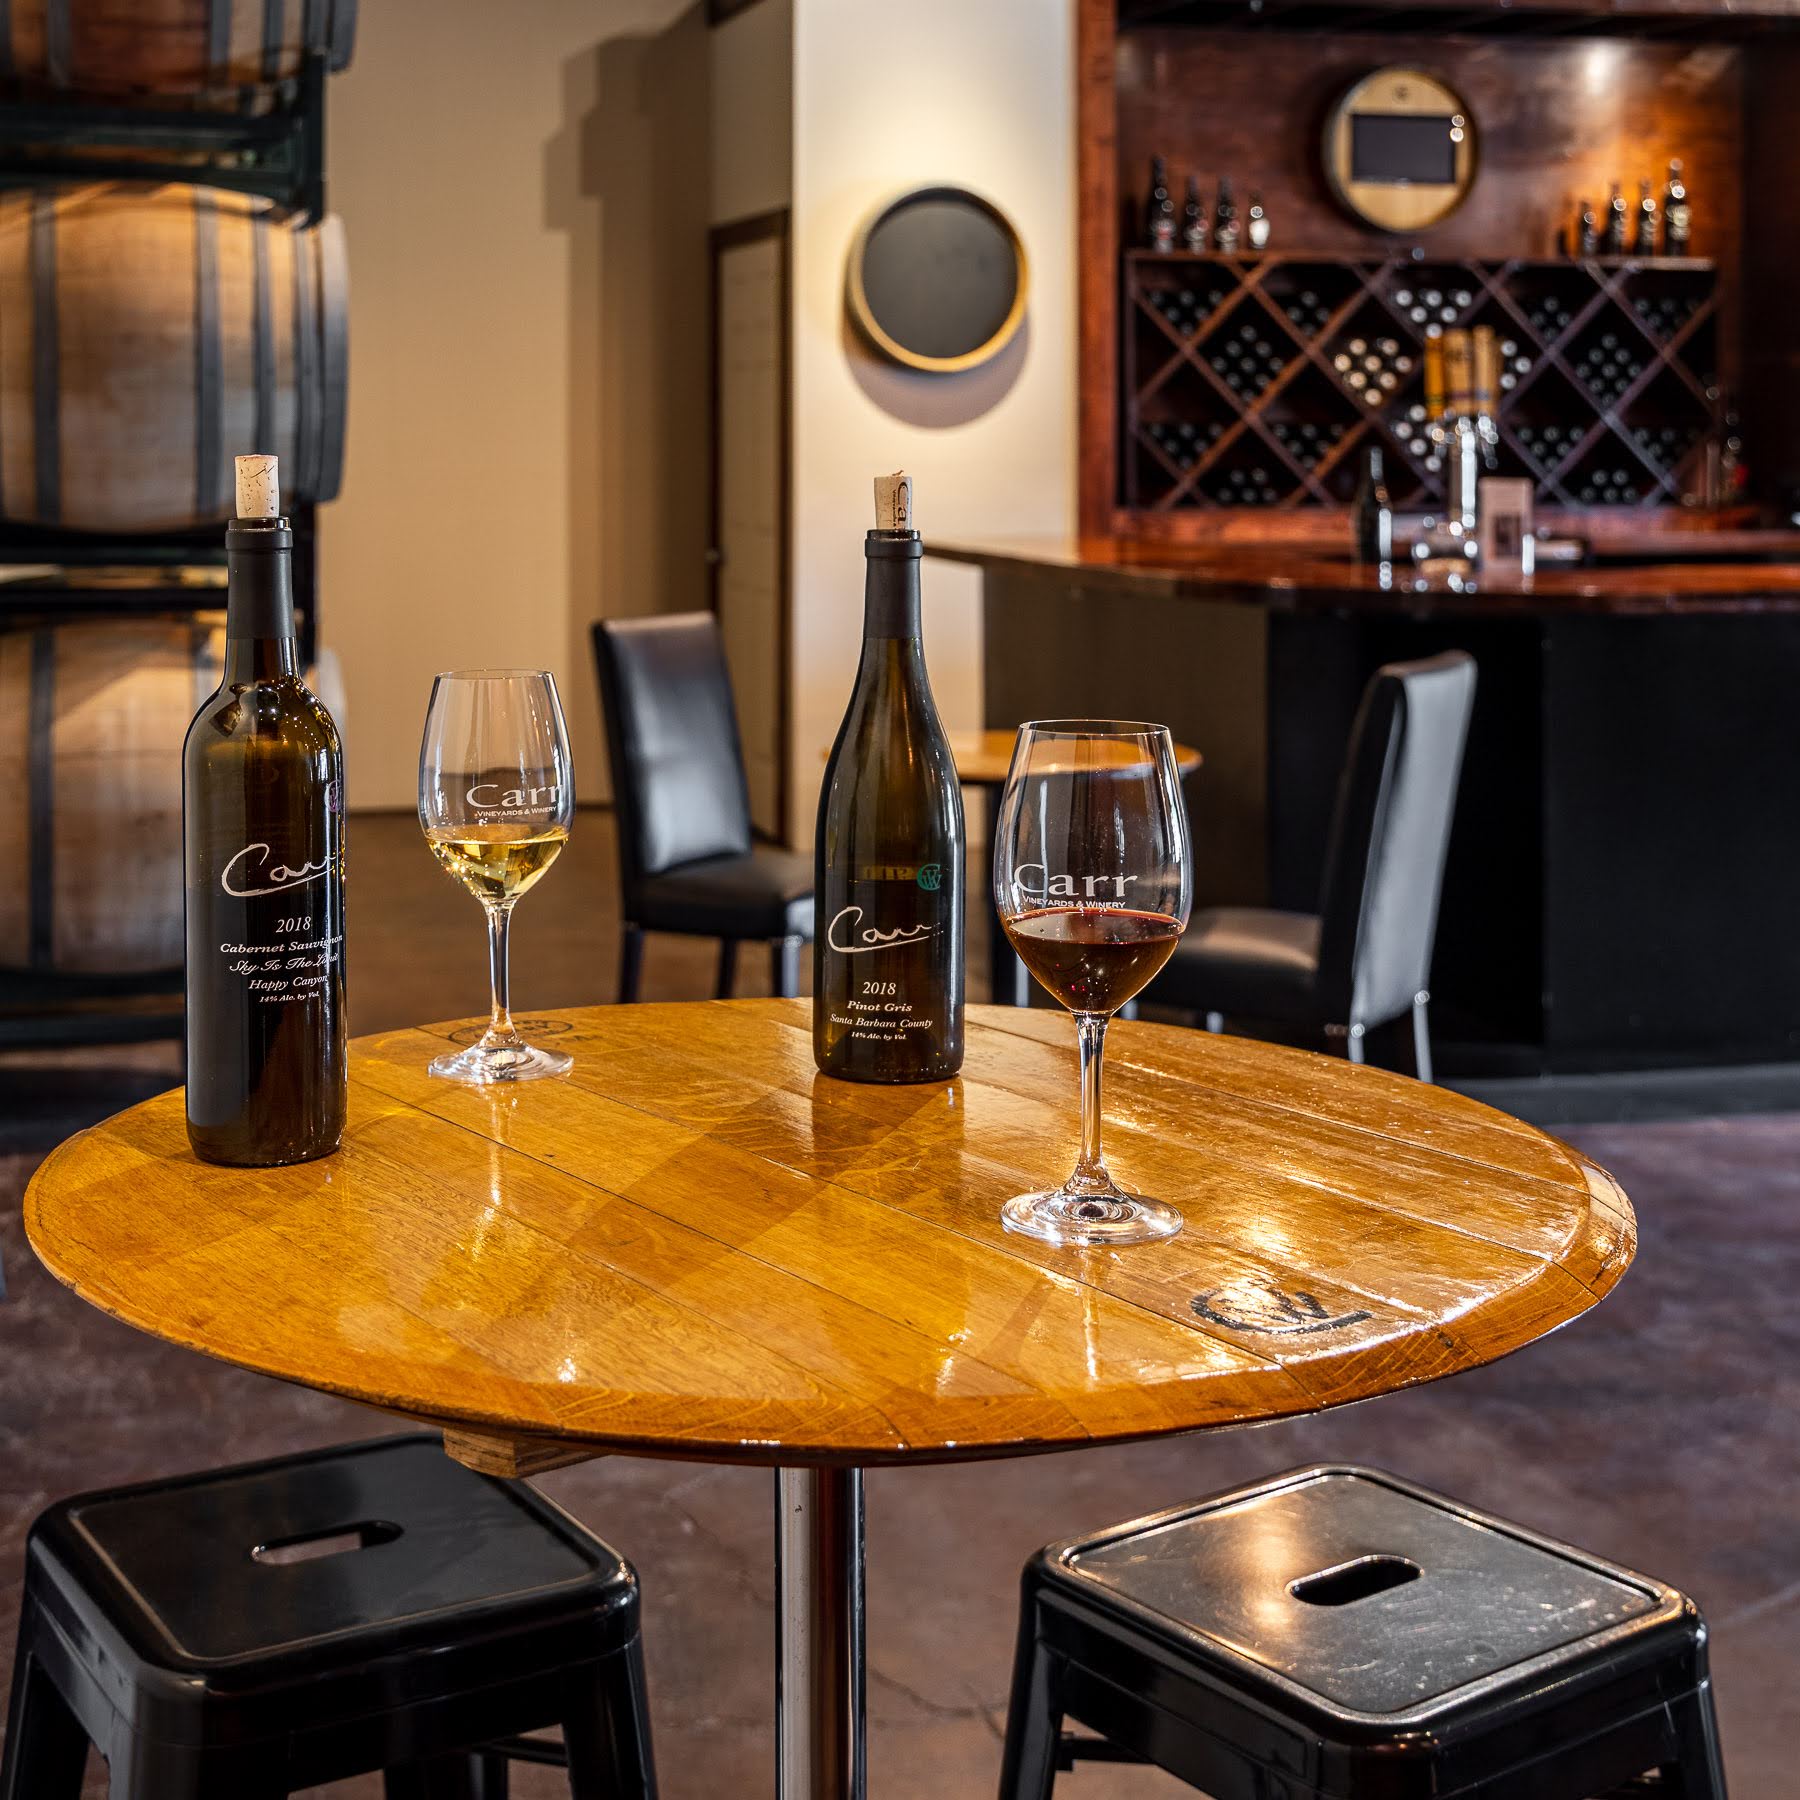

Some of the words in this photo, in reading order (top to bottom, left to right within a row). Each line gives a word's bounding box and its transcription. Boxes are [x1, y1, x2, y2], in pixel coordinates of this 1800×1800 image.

[465, 784, 562, 808] Carr
[531, 806, 557, 814] WINERY
[1014, 863, 1138, 898] Carr
[1023, 896, 1074, 908] VINEYARDS
[1075, 900, 1084, 908] &
[1085, 901, 1126, 909] WINERY
[275, 916, 311, 933] 2018
[220, 943, 285, 953] Cabernet
[229, 960, 260, 976] Sky
[285, 957, 313, 970] The
[248, 980, 288, 991] Happy
[292, 974, 329, 987] Canyon
[862, 981, 896, 995] 2018
[847, 1000, 881, 1011] Pinot
[884, 1002, 913, 1012] Gris
[830, 1013, 853, 1025] Santa
[855, 1017, 897, 1028] Barbara
[899, 1019, 933, 1029] County
[883, 1033, 893, 1041] by
